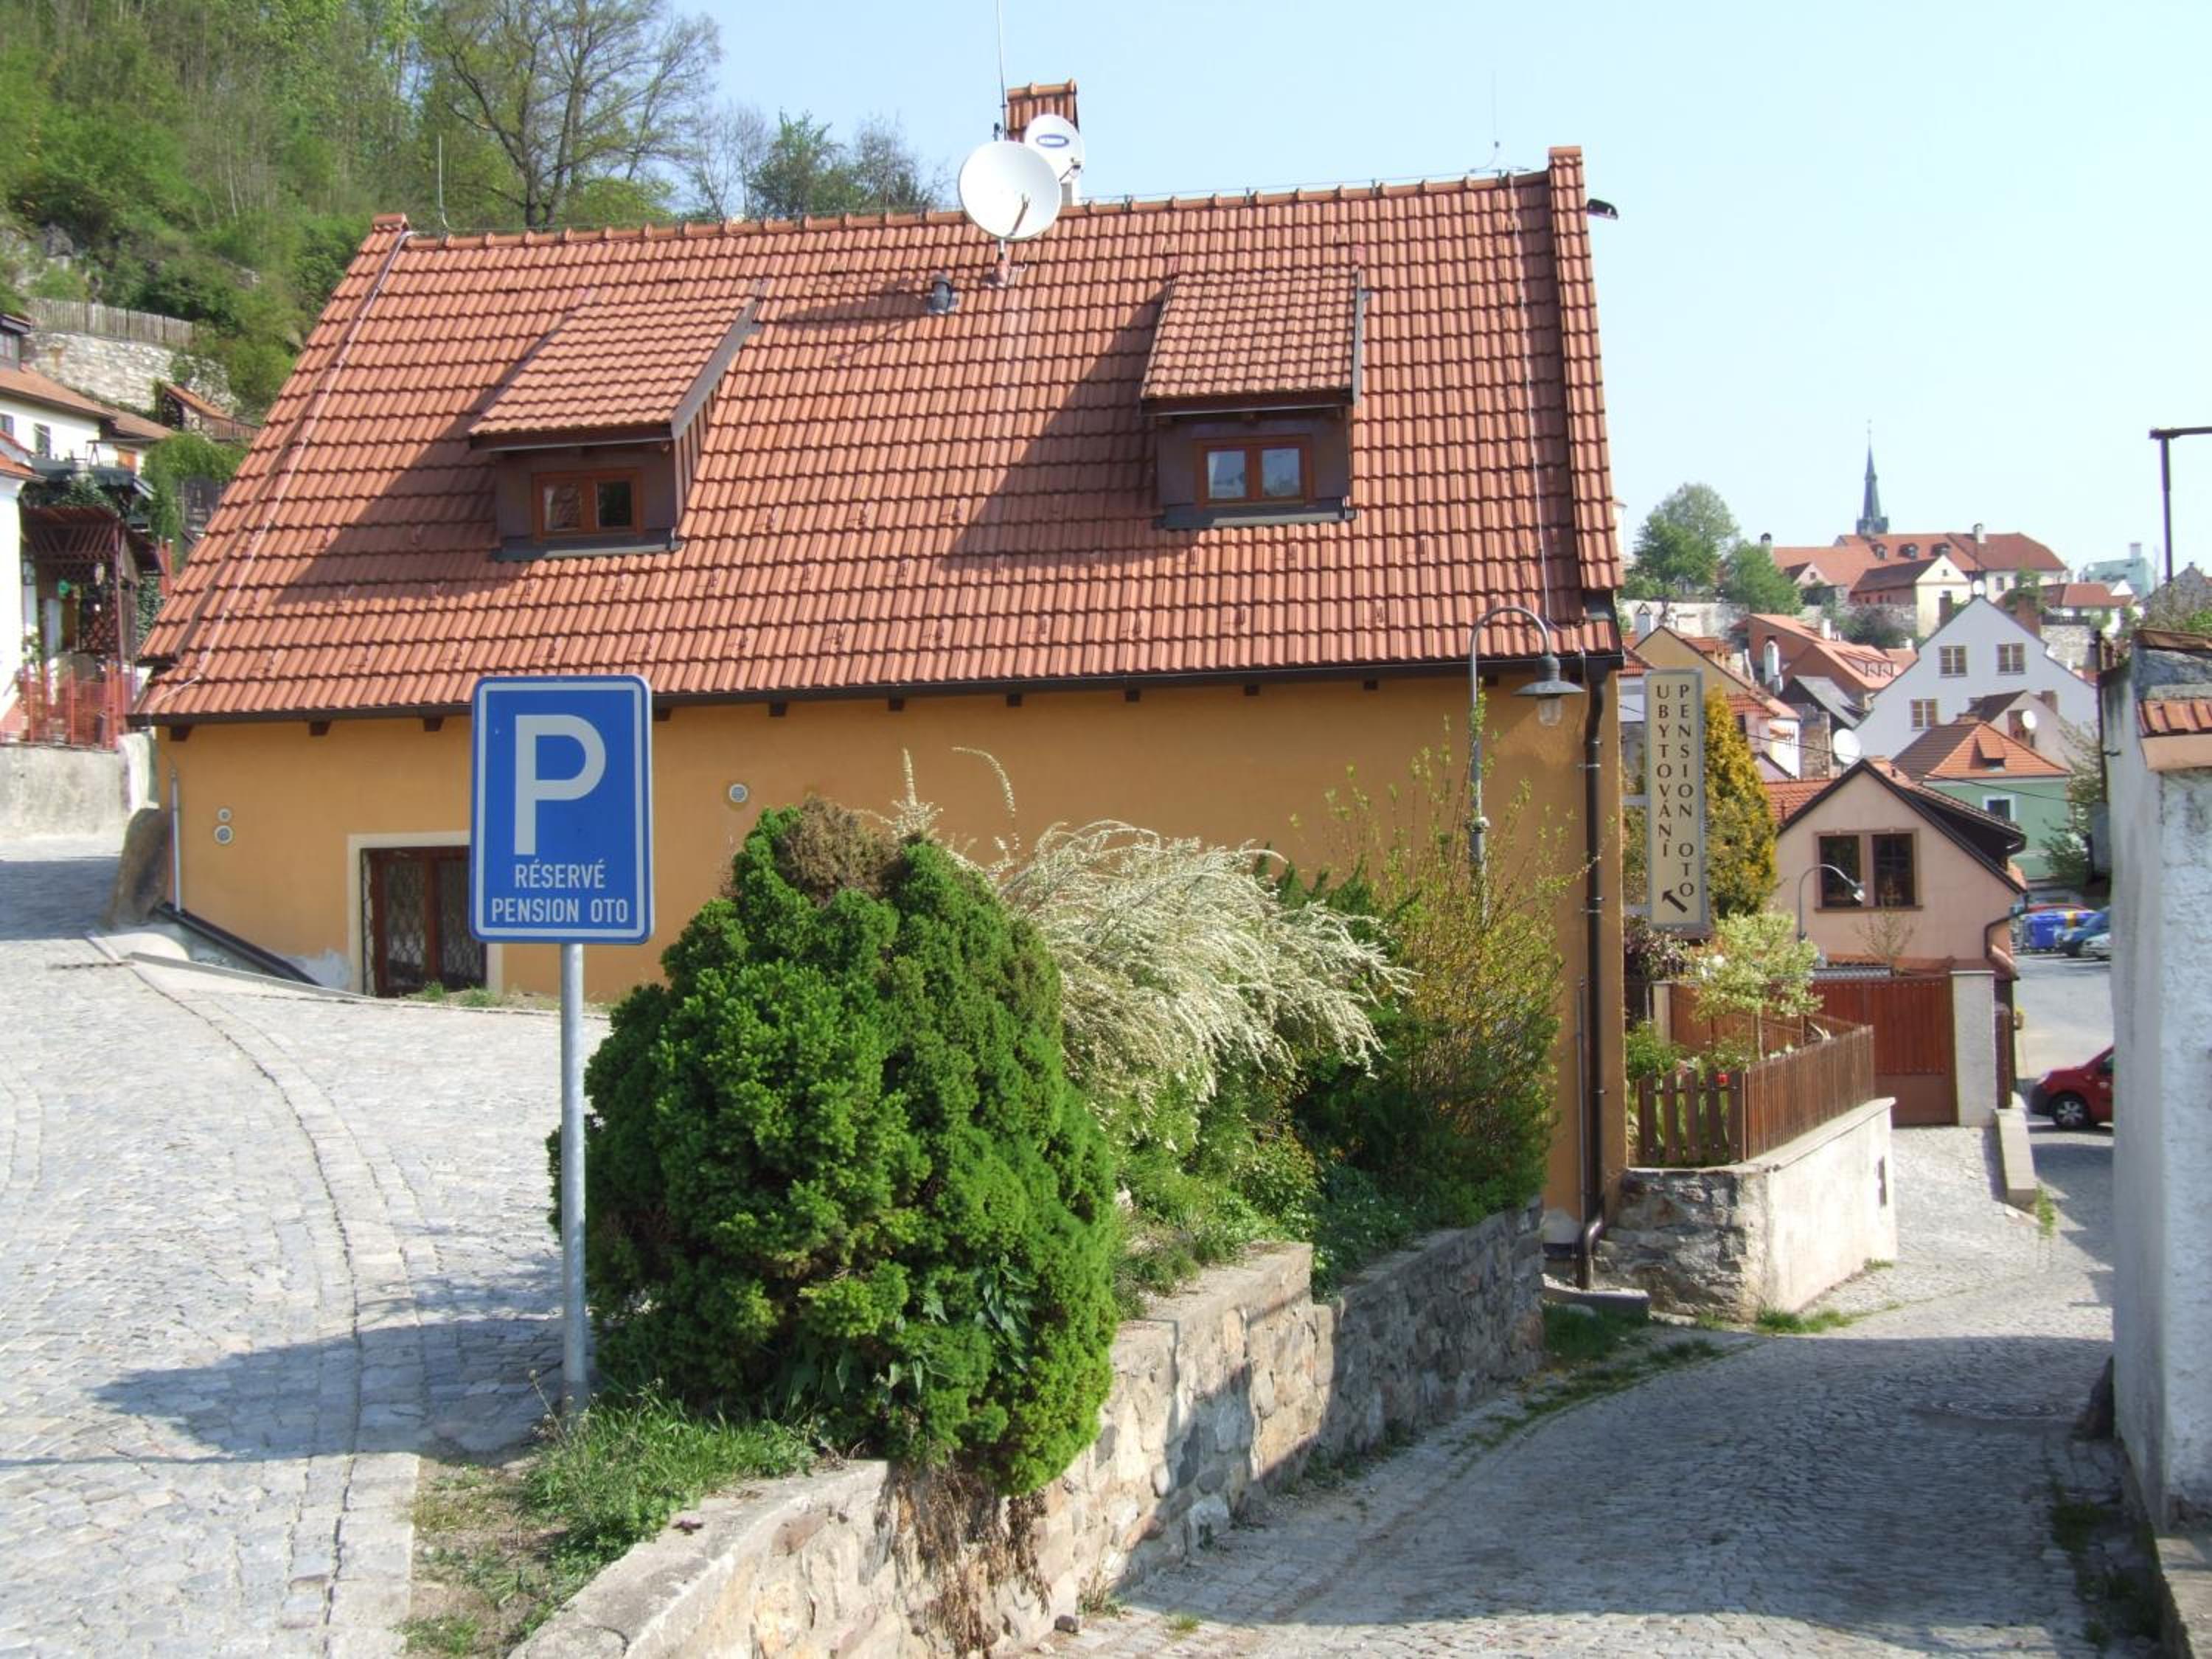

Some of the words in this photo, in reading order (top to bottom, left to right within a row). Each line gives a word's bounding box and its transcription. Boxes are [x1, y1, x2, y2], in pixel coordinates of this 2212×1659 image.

[514, 714, 606, 855] P
[1656, 684, 1672, 858] UBYTOVÁNÍ
[1677, 684, 1694, 818] PENSION
[491, 897, 579, 922] PENSION
[590, 898, 628, 923] OTO
[515, 859, 605, 888] RÉSERVÉ
[1677, 843, 1694, 897] OTO
